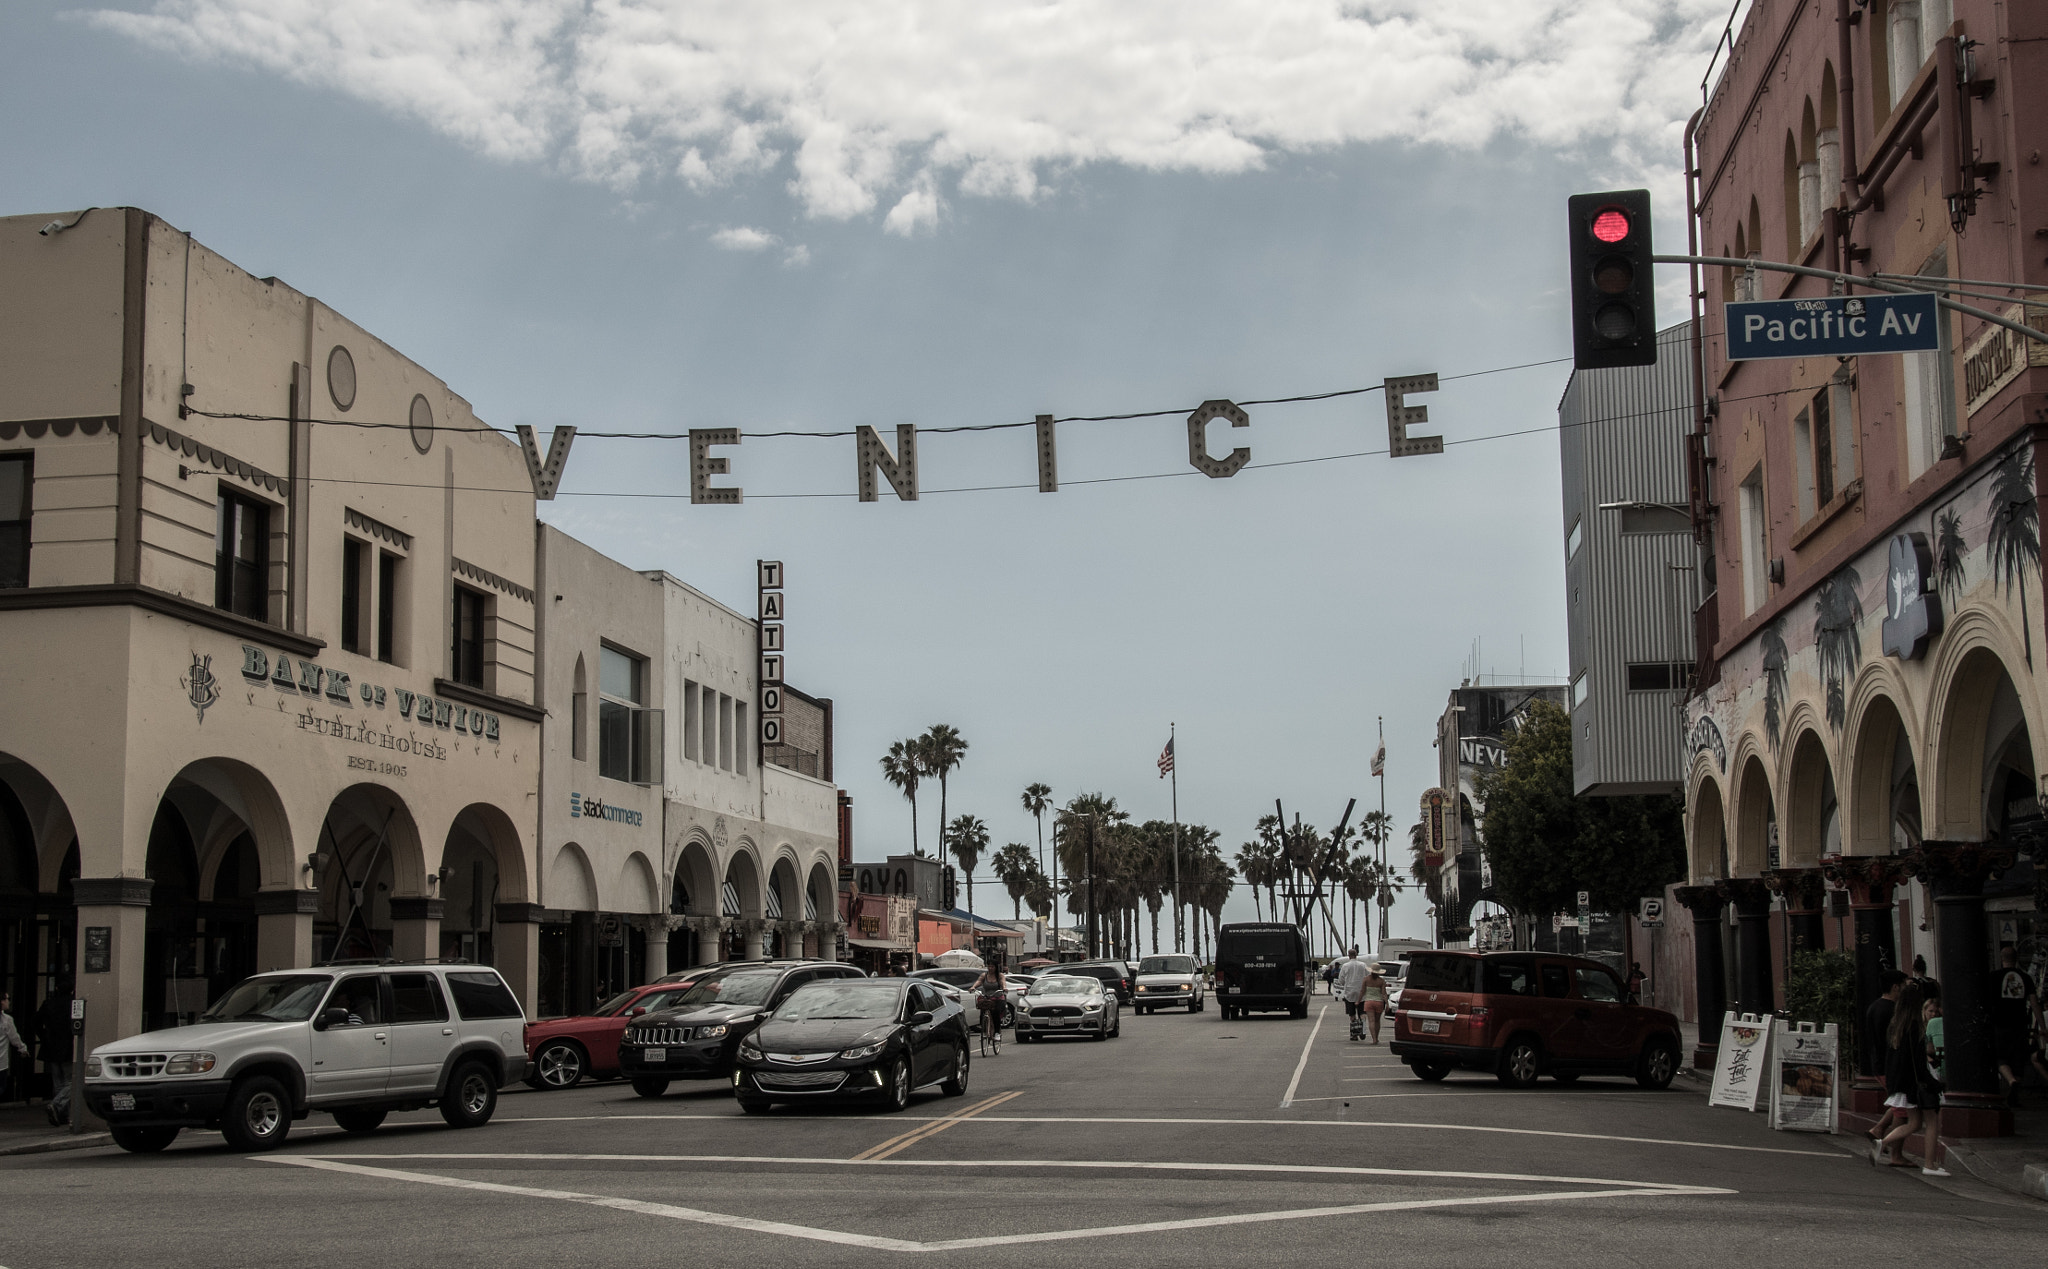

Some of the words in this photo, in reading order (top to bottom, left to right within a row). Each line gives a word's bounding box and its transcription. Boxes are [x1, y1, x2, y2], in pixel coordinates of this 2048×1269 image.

[1744, 309, 1867, 343] Pacific
[1879, 307, 1923, 336] Av
[1963, 327, 2013, 405] HOSTEL
[515, 372, 1444, 505] VENICE
[763, 564, 778, 741] TATTOO
[241, 644, 353, 706] BANK
[359, 682, 388, 706] OF
[394, 687, 500, 742] VENICE
[298, 712, 377, 746] PUBLIC
[379, 734, 448, 761] HOUSE
[379, 761, 408, 778] 1905
[584, 797, 643, 827] stackcommerce
